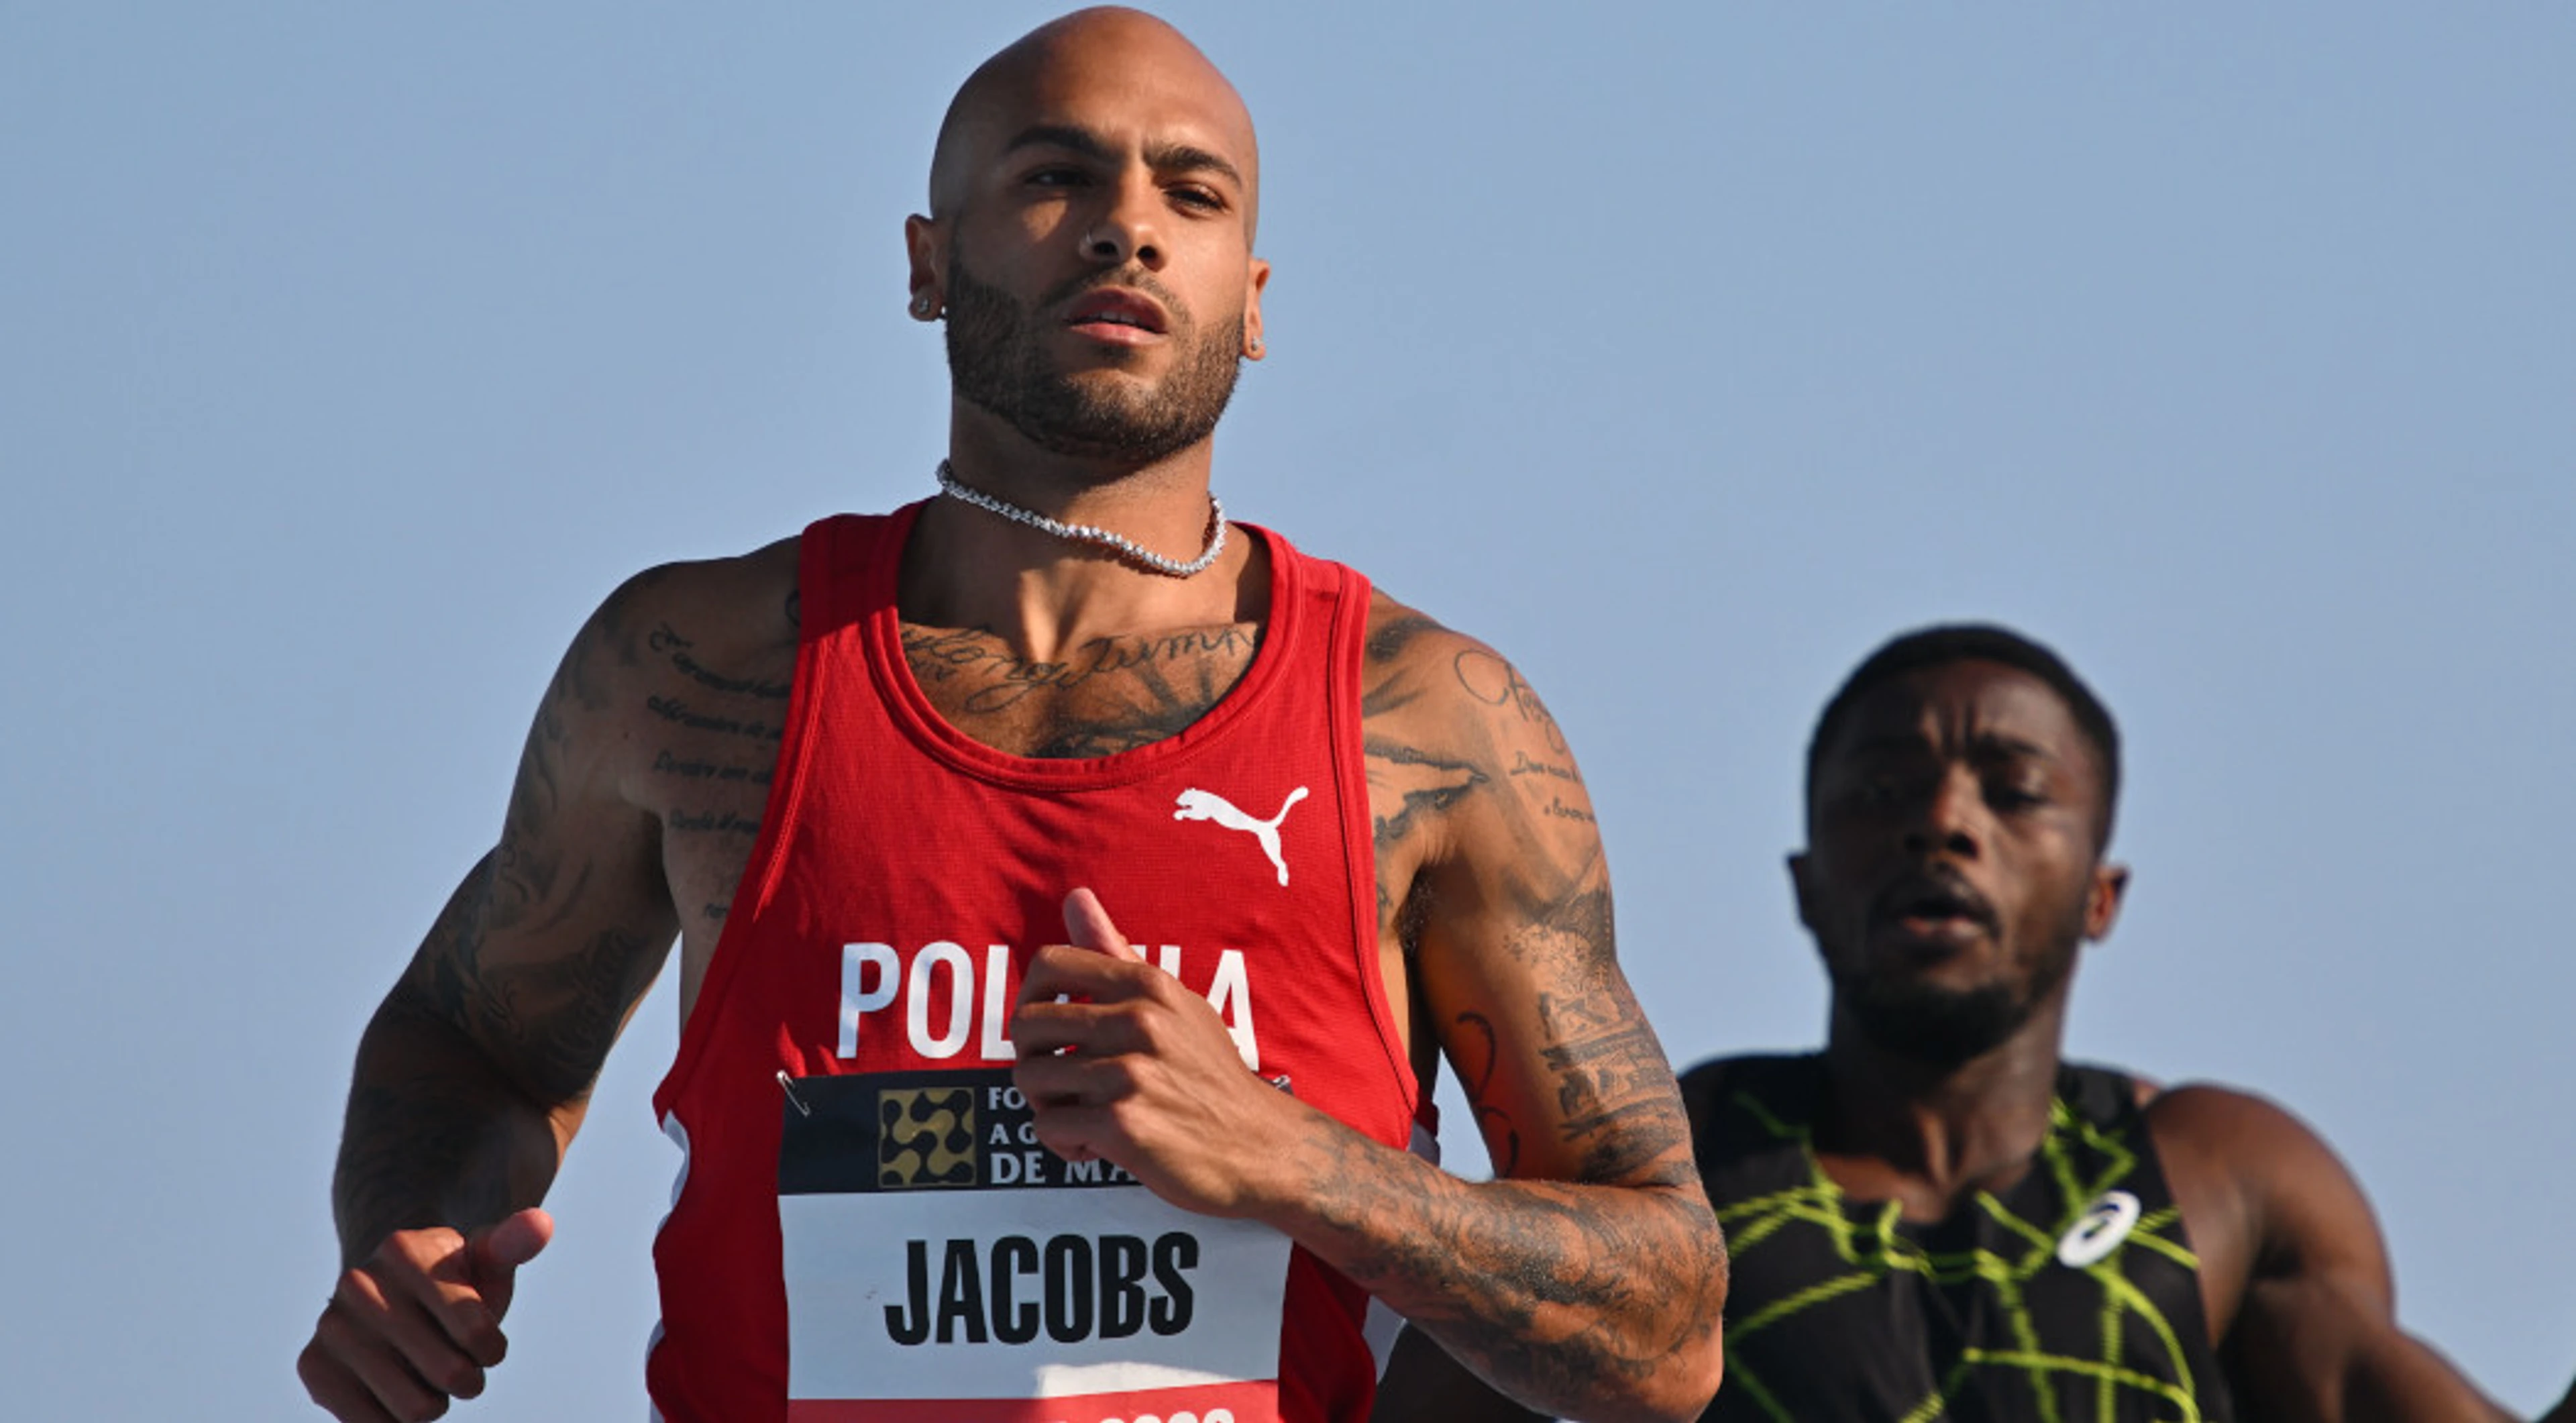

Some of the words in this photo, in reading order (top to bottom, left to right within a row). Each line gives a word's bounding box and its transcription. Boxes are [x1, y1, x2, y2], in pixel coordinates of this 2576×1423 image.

[837, 941, 1258, 1072] POLA
[988, 1087, 1026, 1110] FO
[988, 1123, 1011, 1145] A
[991, 1151, 1046, 1184] DE
[1064, 1159, 1138, 1183] MA
[883, 1232, 1198, 1346] JACOBS
